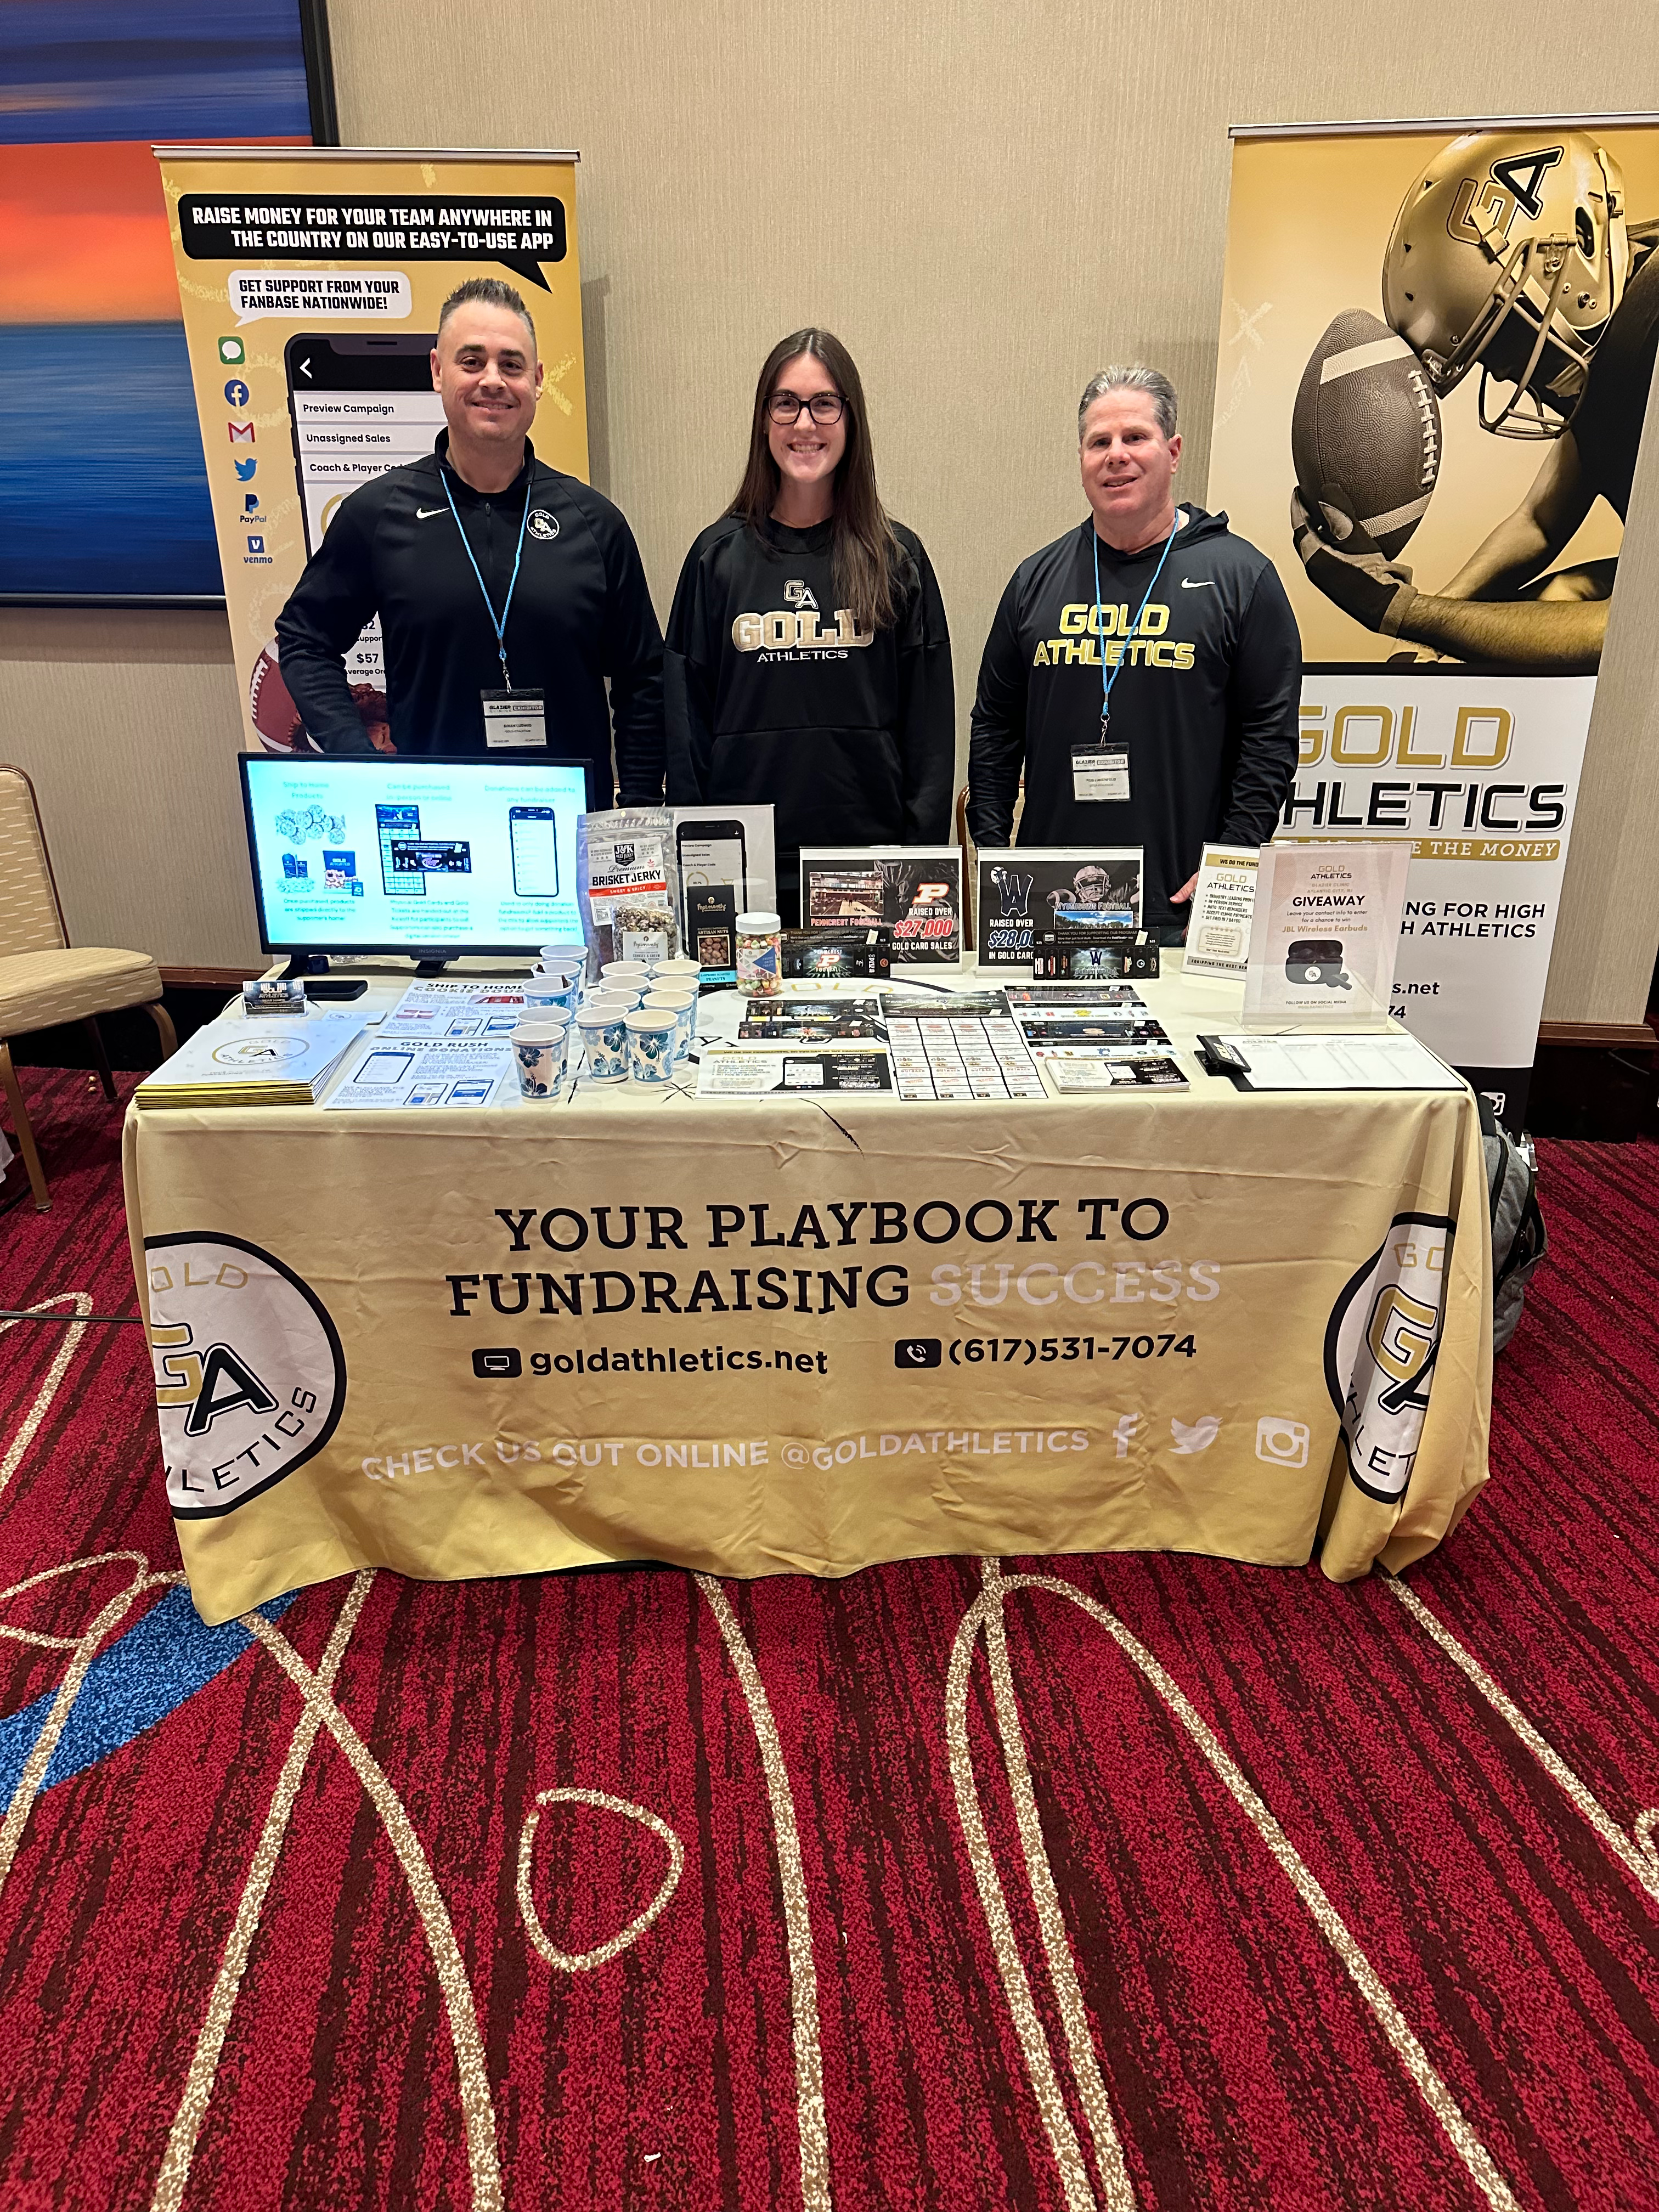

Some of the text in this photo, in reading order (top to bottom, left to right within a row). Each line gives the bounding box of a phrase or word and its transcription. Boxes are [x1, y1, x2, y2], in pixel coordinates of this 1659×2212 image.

[193, 207, 552, 227] RAISE MONEY FOR YOUR TEAM ANYWHERE IN
[232, 230, 553, 250] THE COUNTRY ON OUR EASY-TO-USE APP
[239, 280, 400, 294] GET SUPPORT FROM YOUR
[241, 297, 388, 310] FANBASE NATIONWIDE!
[303, 404, 394, 415] Preview Campaign
[307, 433, 391, 445] Unassigned Sales
[310, 463, 341, 472] Coach
[343, 464, 351, 472] &
[353, 463, 382, 474] Player
[240, 514, 267, 524] PayPal
[244, 555, 273, 563] venmo
[1059, 603, 1170, 636] GOLD
[732, 609, 874, 652] GOLD
[356, 653, 379, 664] $57
[757, 650, 848, 662] ATHLETICS
[1034, 639, 1195, 670] ATHLETICS
[616, 844, 634, 854] J&K
[1430, 841, 1472, 855] THE
[1480, 843, 1558, 857] MONEY
[607, 865, 645, 873] Premium
[592, 870, 661, 886] BRISKET JERKY
[1216, 873, 1246, 883] GOLD
[912, 883, 949, 904] P
[1207, 882, 1254, 893] ATHLETICS
[1098, 902, 1131, 910] FOOTBALL
[1293, 895, 1365, 907] GIVEAWAY
[934, 907, 952, 916] OVER
[1443, 902, 1488, 918] FOR
[1496, 903, 1546, 919] HIGH
[850, 918, 883, 926] FOOTBALL
[989, 919, 1034, 927] RAISED OVER
[894, 918, 953, 939] $27,000
[1421, 922, 1536, 938] ATHLETICS
[892, 942, 909, 950] GOLD
[930, 941, 952, 950] SALES
[997, 951, 1015, 960] GOLD
[494, 1198, 1170, 1252] YOUR PLAYBOOK TO
[445, 1260, 1221, 1316] FUNDRAISING SUCCESS
[949, 1334, 1197, 1366] (617)531-7074
[529, 1346, 828, 1375] goldathletics.net
[361, 1429, 1090, 1481] CHECK US OUT ONLINE @GOLDATHLETICS
